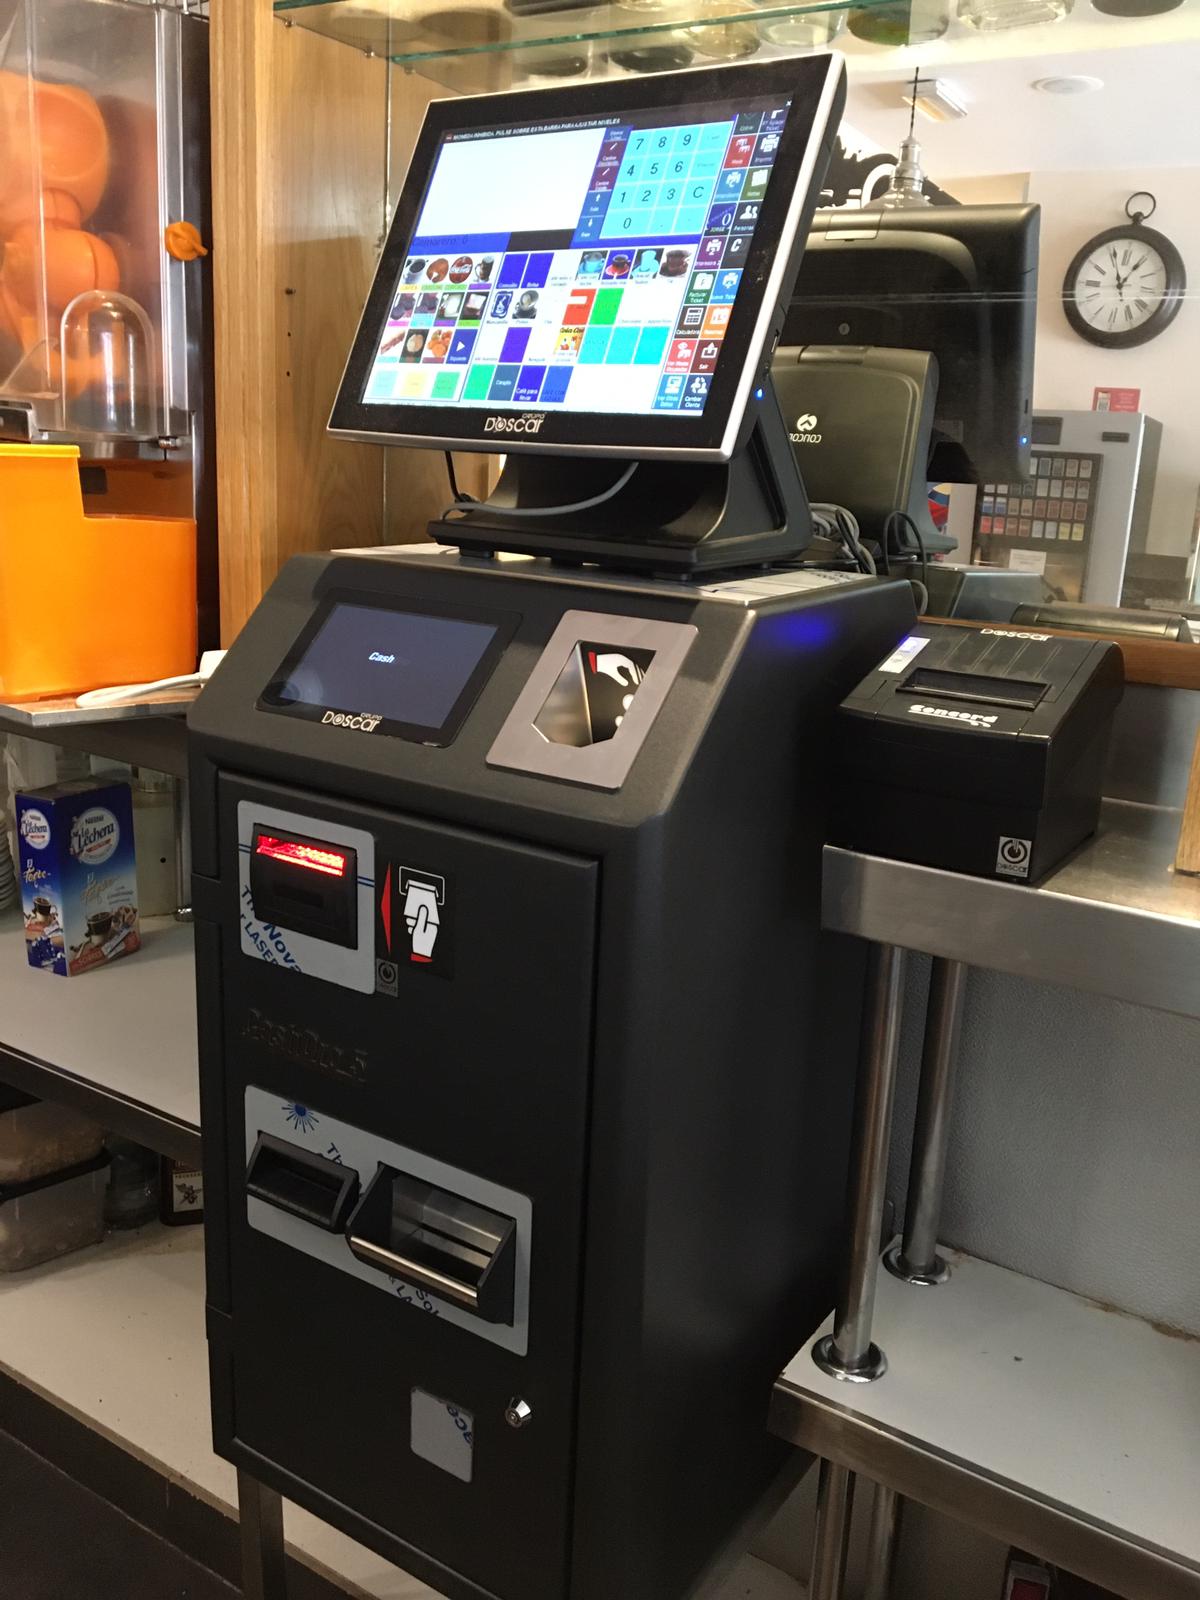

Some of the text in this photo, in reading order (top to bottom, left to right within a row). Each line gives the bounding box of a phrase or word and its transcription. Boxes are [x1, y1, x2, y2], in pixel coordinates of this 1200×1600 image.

[512, 126, 530, 134] SOBRE
[636, 134, 692, 150] 7 8 9
[626, 164, 635, 177] 4
[650, 162, 658, 175] 5
[674, 160, 684, 172] 6
[620, 191, 626, 203] 1
[642, 190, 652, 202] 2
[666, 188, 676, 200] 3
[693, 186, 704, 198] C
[623, 217, 632, 229] 0
[730, 238, 742, 252] C
[522, 412, 546, 420] GRUPO
[368, 651, 396, 664] Cash
[25, 824, 48, 835] Lechera
[78, 823, 114, 850] Lechera
